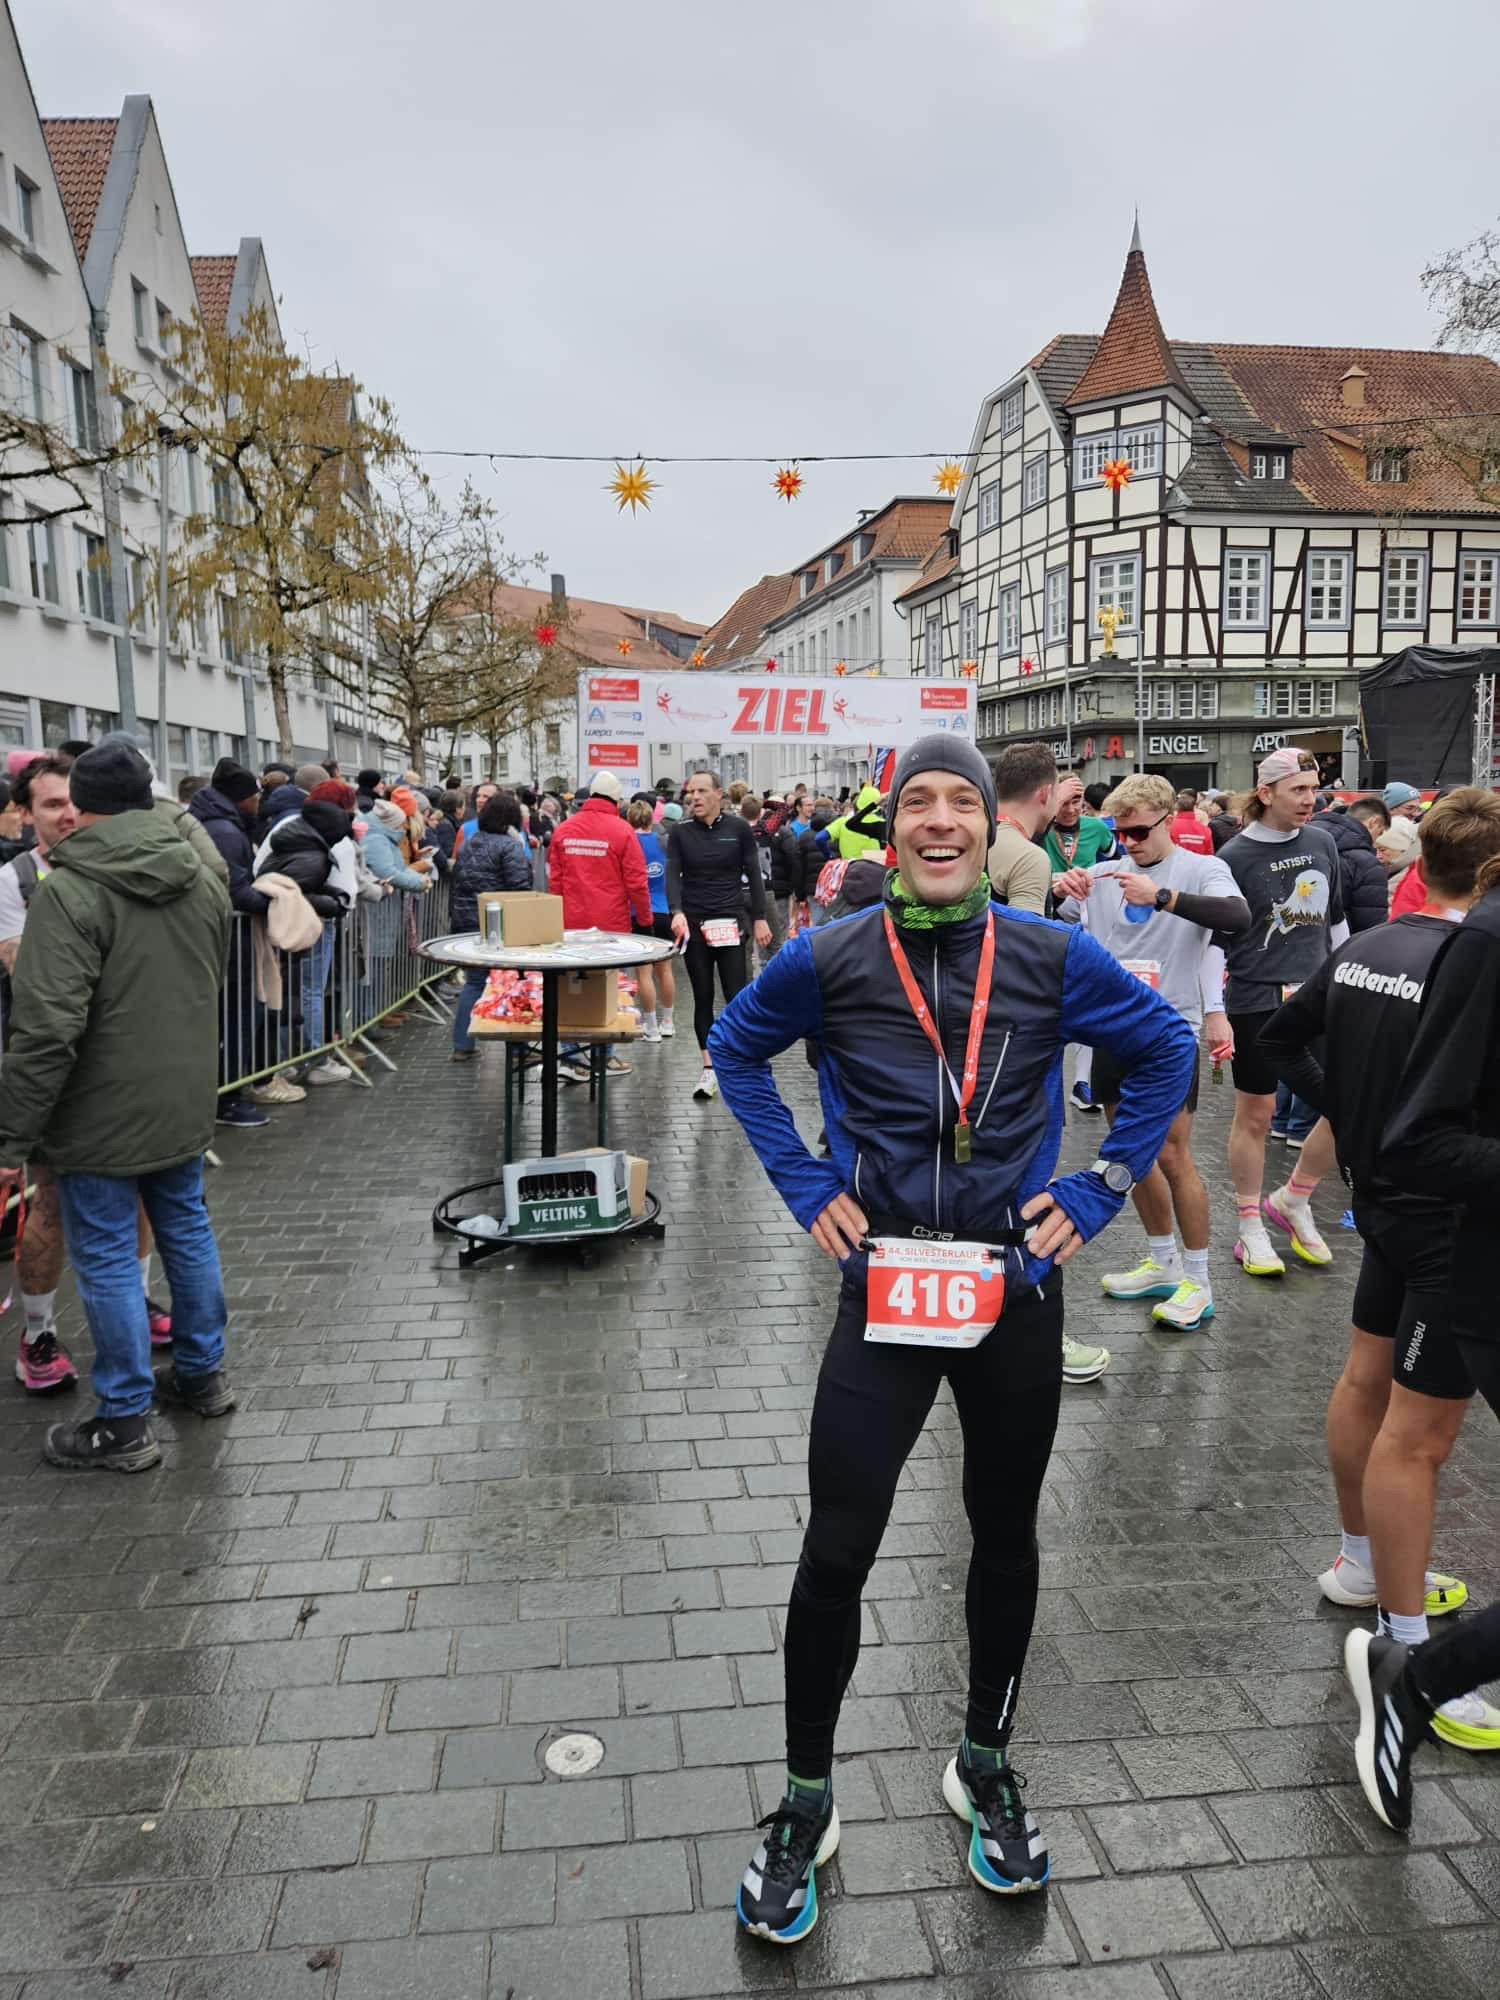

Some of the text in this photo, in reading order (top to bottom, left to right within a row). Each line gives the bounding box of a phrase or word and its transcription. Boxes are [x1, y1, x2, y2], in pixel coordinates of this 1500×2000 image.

[731, 687, 830, 735] ZIEL
[1148, 735, 1209, 754] ENGEL
[1270, 855, 1313, 872] SATISFY
[532, 1205, 587, 1222] VELTINS
[905, 1247, 978, 1259] SILVESTERLAUF
[887, 1272, 977, 1320] 416
[1403, 1321, 1427, 1372] newline
